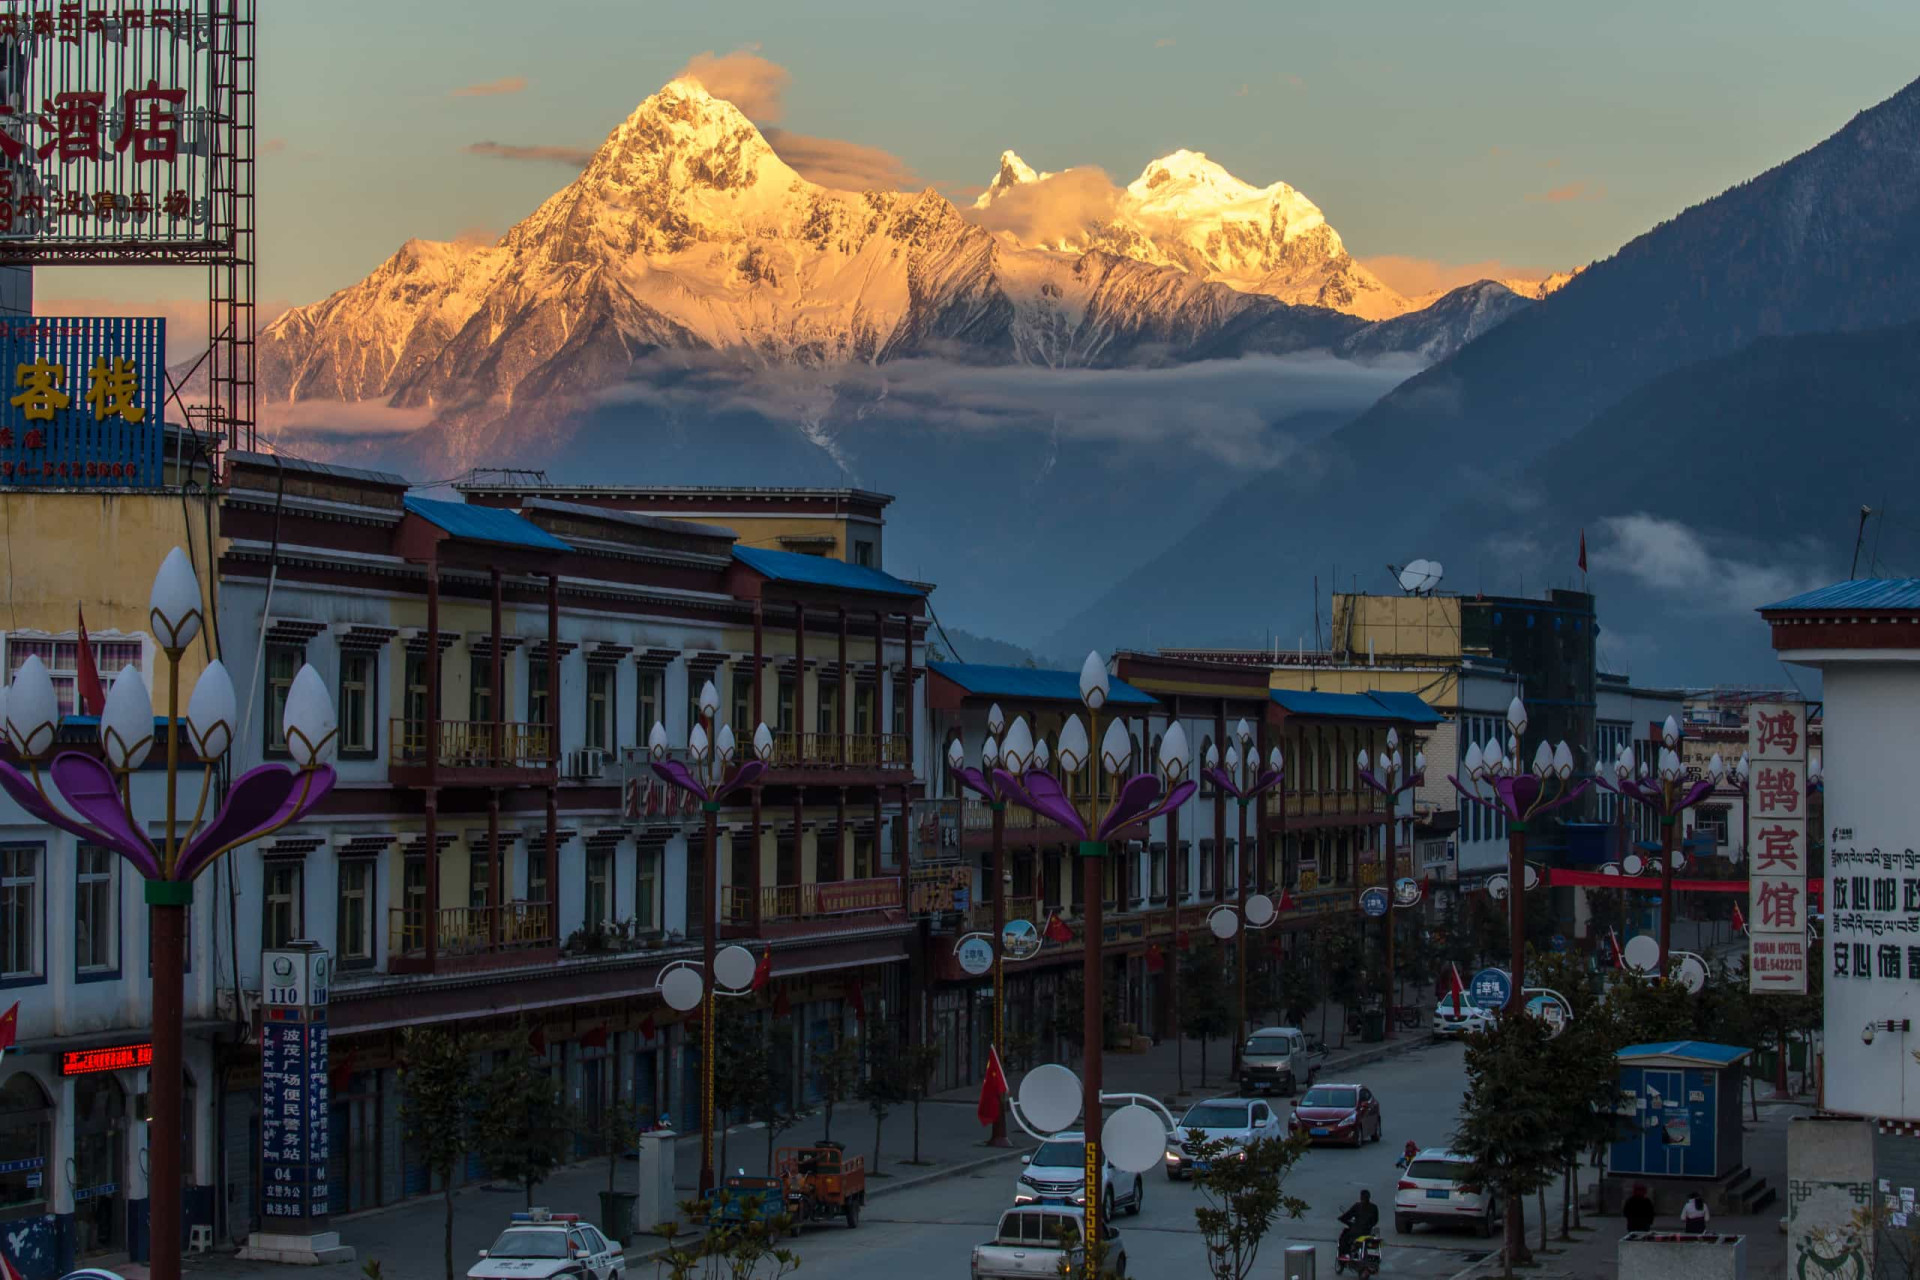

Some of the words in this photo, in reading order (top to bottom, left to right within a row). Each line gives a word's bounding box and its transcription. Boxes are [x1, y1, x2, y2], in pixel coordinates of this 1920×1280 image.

[10, 356, 146, 423] 客栈
[1756, 709, 1800, 928] 鸿鹄宾馆
[1753, 942, 1775, 955] SWAN
[1778, 942, 1802, 955] HOTEL
[270, 988, 297, 1004] 110
[274, 1167, 292, 1181] 04
